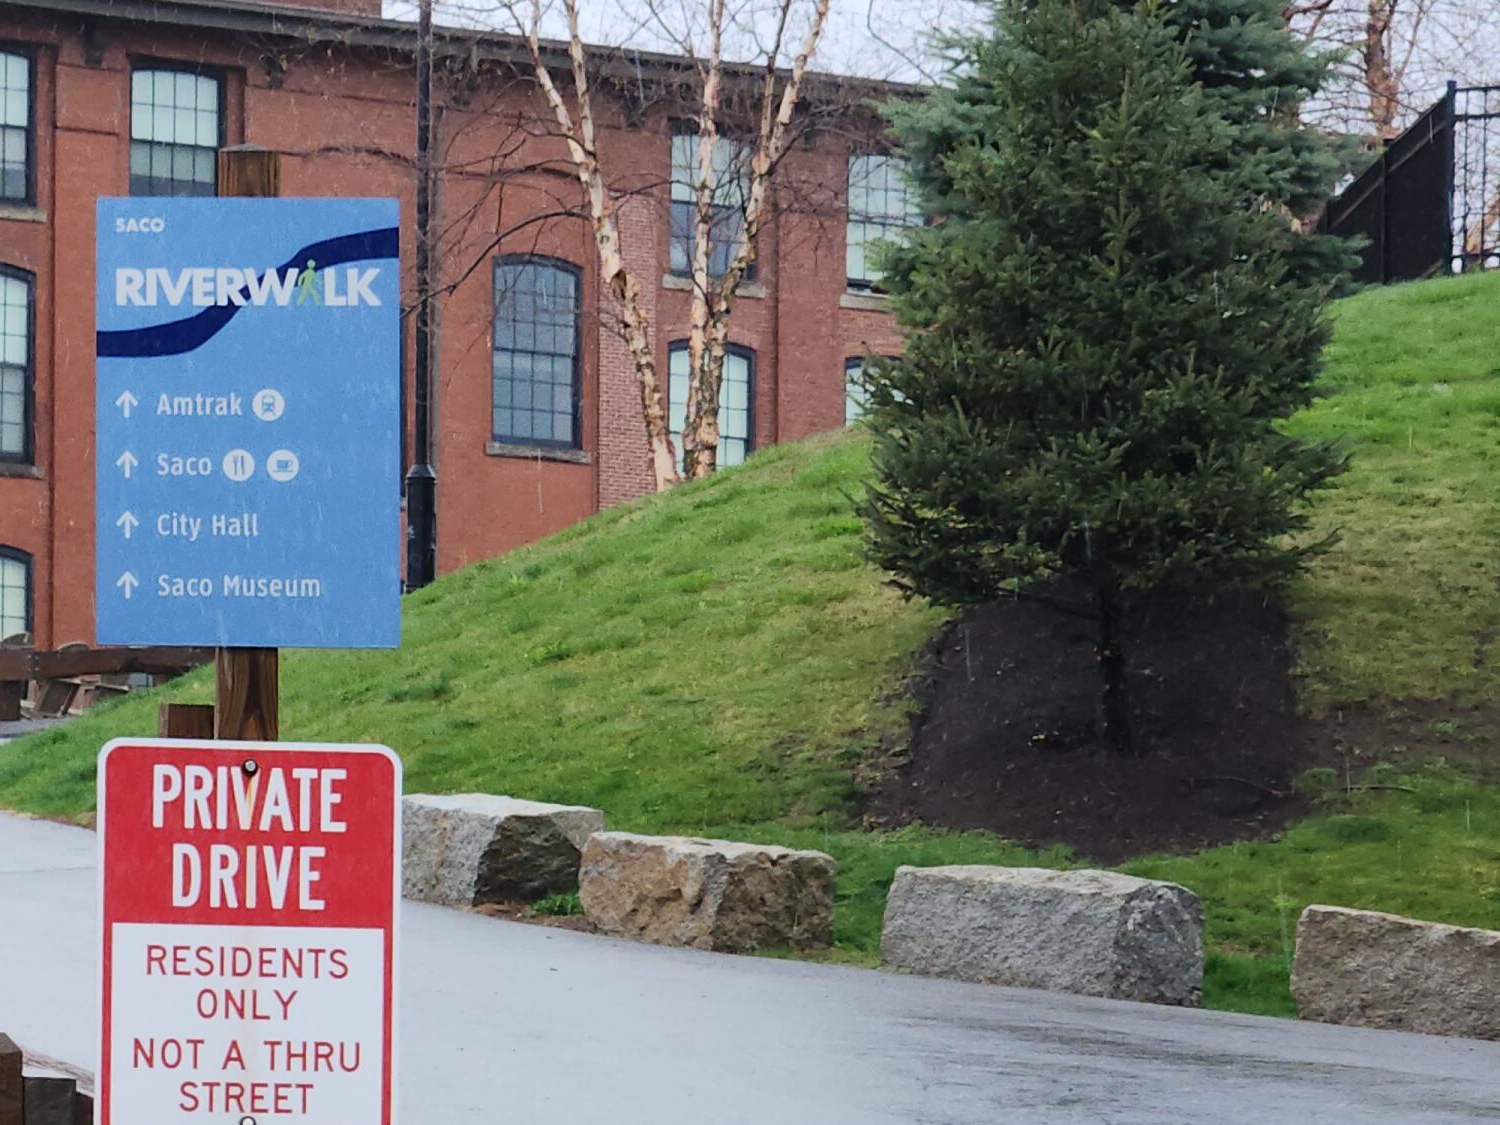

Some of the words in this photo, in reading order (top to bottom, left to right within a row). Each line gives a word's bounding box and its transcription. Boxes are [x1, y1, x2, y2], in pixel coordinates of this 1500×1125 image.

[115, 218, 166, 233] SACO
[156, 393, 242, 416] Amtrak
[156, 453, 212, 476] Saco
[156, 513, 201, 541] City
[212, 513, 259, 537] Hall
[157, 574, 213, 597] Saco
[223, 576, 322, 597] Museum
[152, 763, 348, 832] PRIVATE
[171, 843, 326, 911] DRIVE
[146, 944, 349, 979] RESIDENTS
[196, 988, 298, 1020] ONLY
[133, 1038, 205, 1070] NOT
[222, 1040, 246, 1070] A
[264, 1041, 361, 1073] THRU
[179, 1081, 314, 1114] STREET
